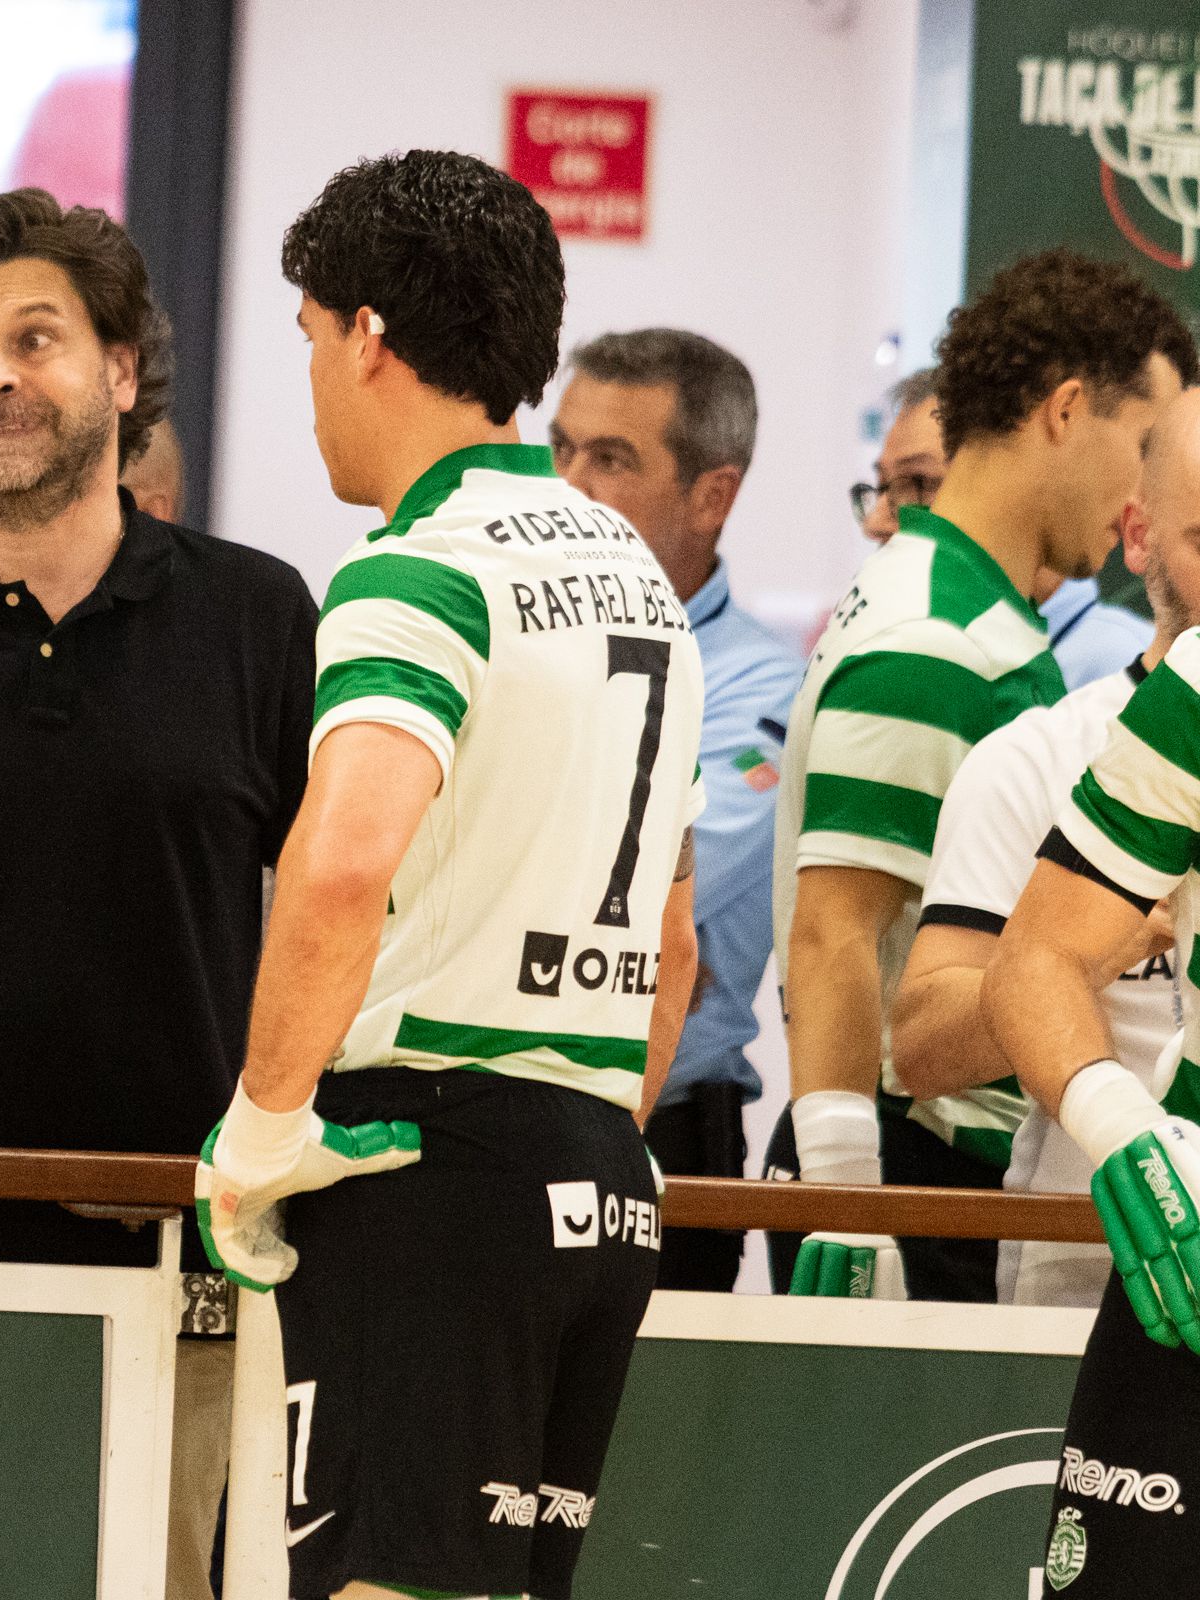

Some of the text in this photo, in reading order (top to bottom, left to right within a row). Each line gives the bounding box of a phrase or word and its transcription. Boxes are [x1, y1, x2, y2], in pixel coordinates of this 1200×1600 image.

[510, 574, 636, 633] RAFAEL
[592, 634, 671, 929] 7
[573, 947, 609, 990] O
[1060, 1446, 1181, 1512] Reno
